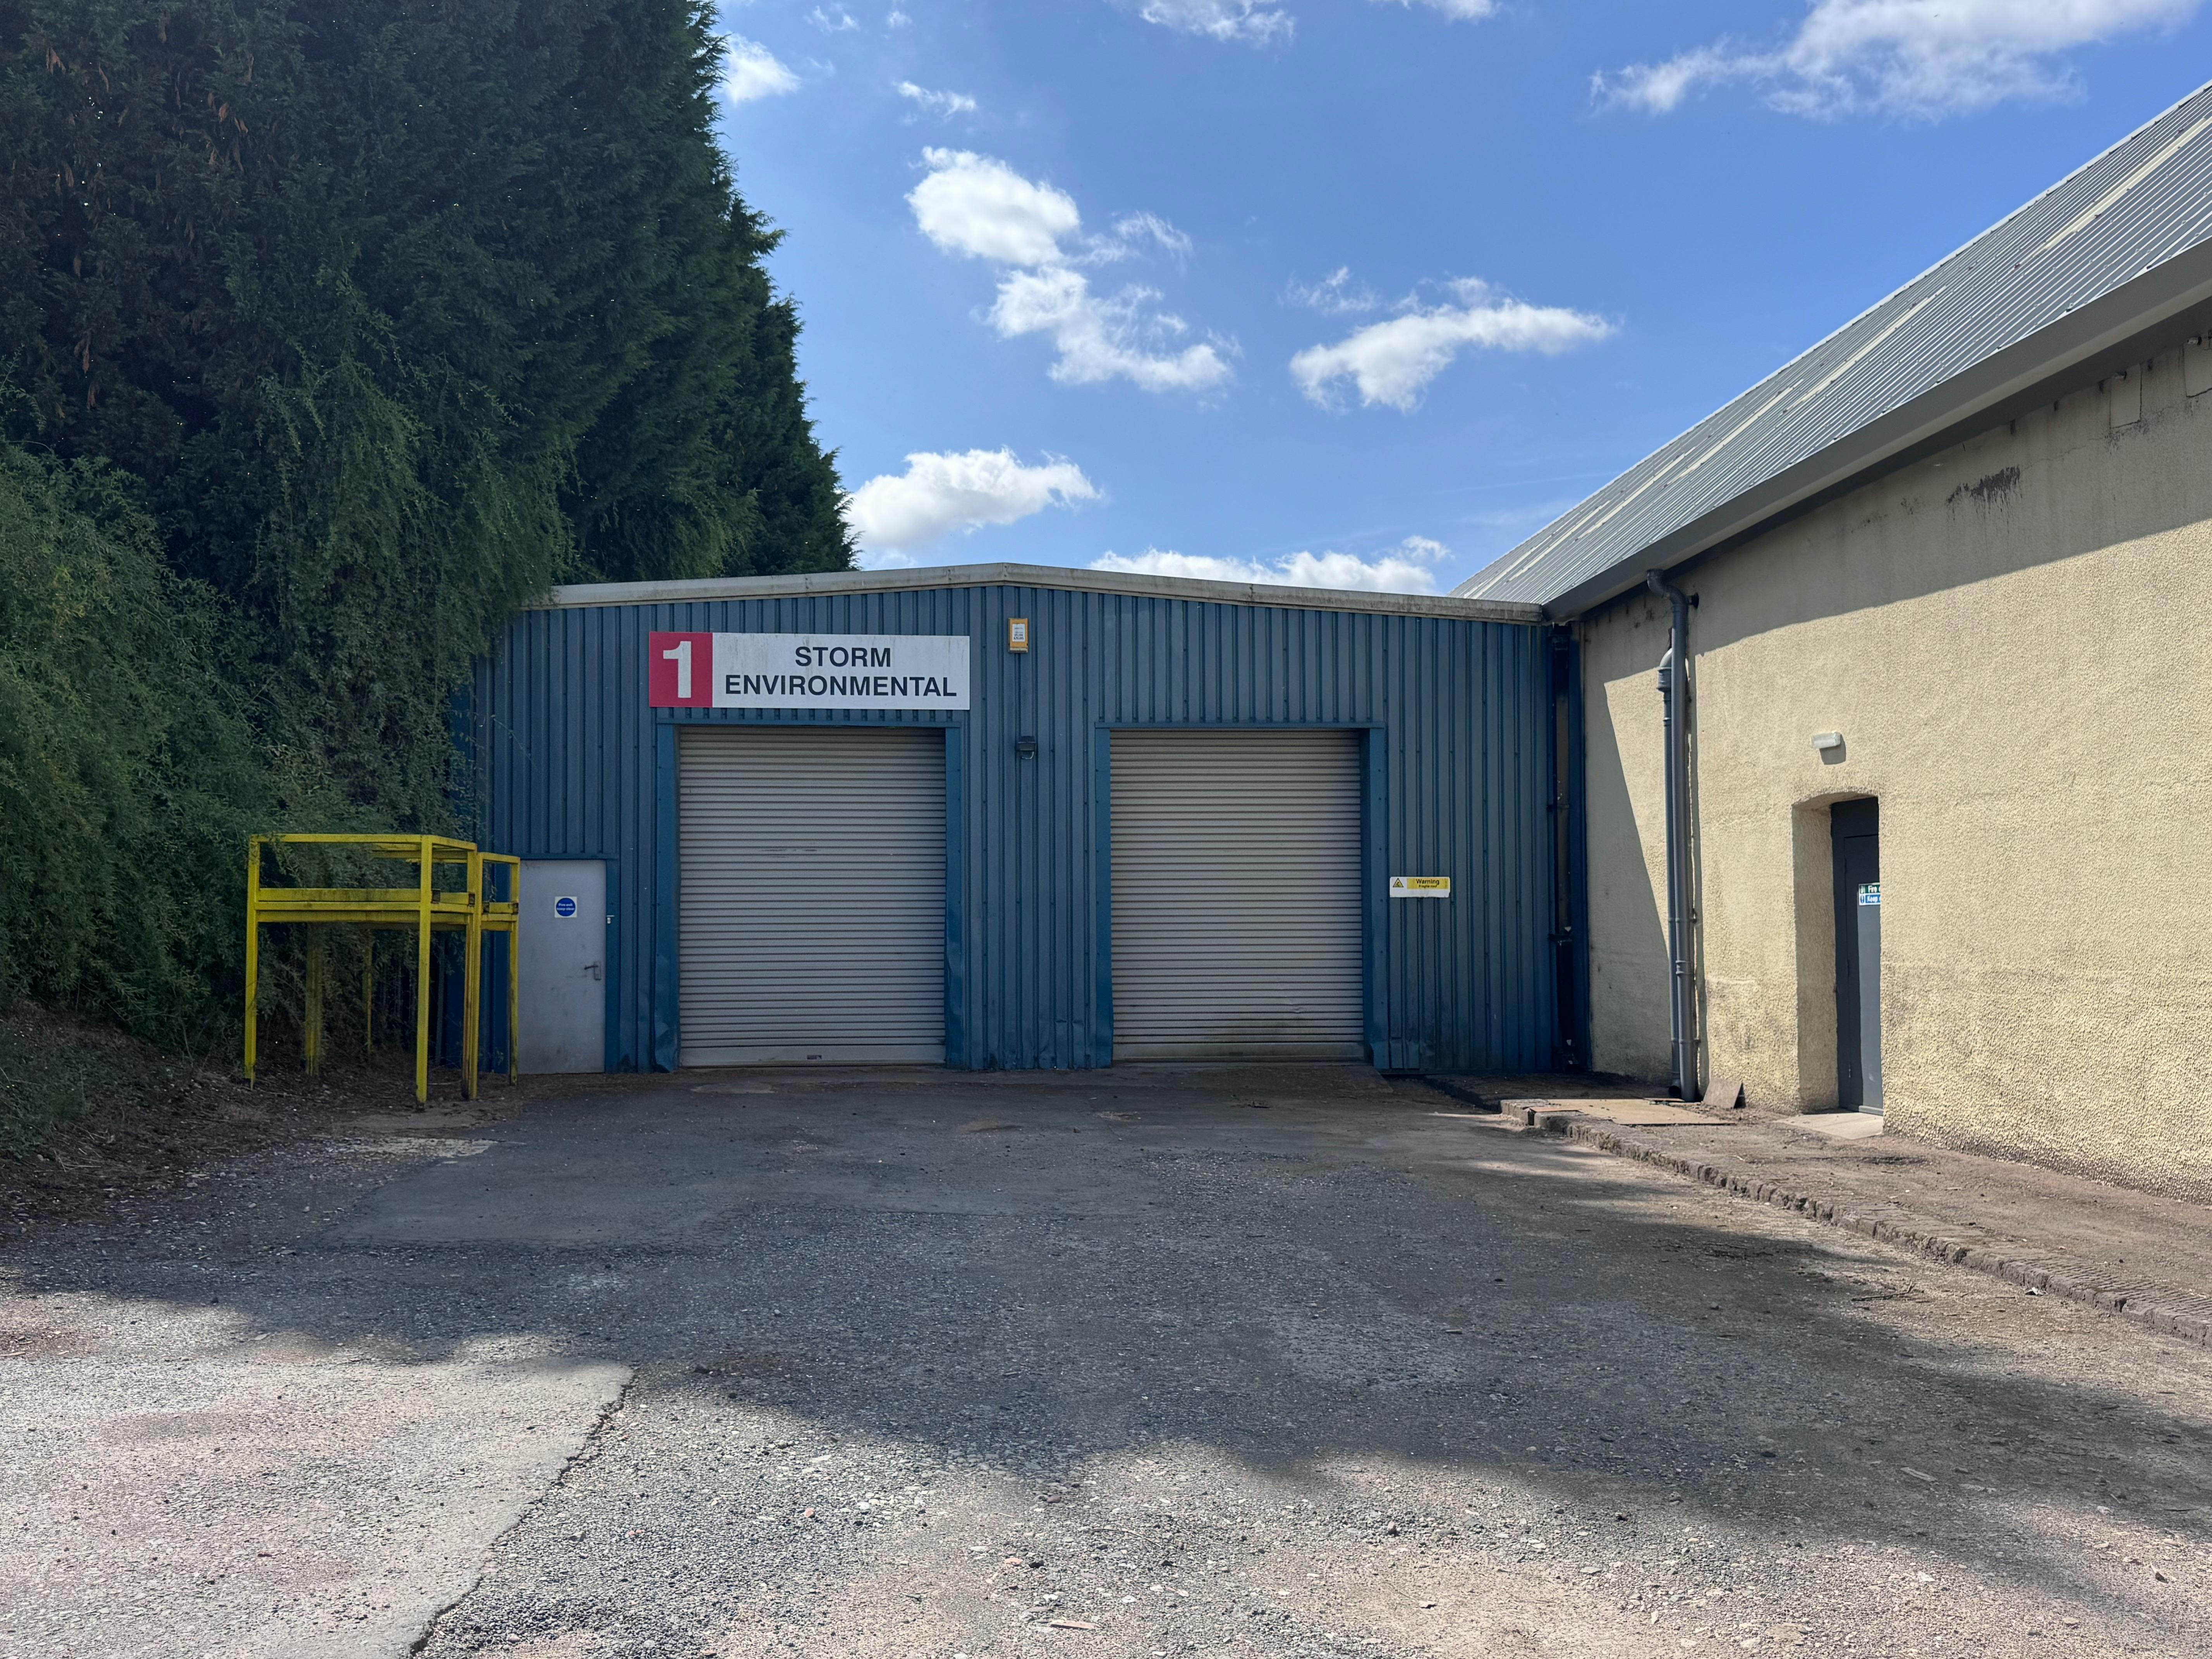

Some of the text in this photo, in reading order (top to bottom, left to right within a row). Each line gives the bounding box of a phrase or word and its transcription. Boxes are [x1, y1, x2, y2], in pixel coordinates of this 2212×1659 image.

[795, 646, 891, 667] STORM
[663, 641, 691, 698] 1
[725, 675, 957, 697] ENVIRONMENTAL
